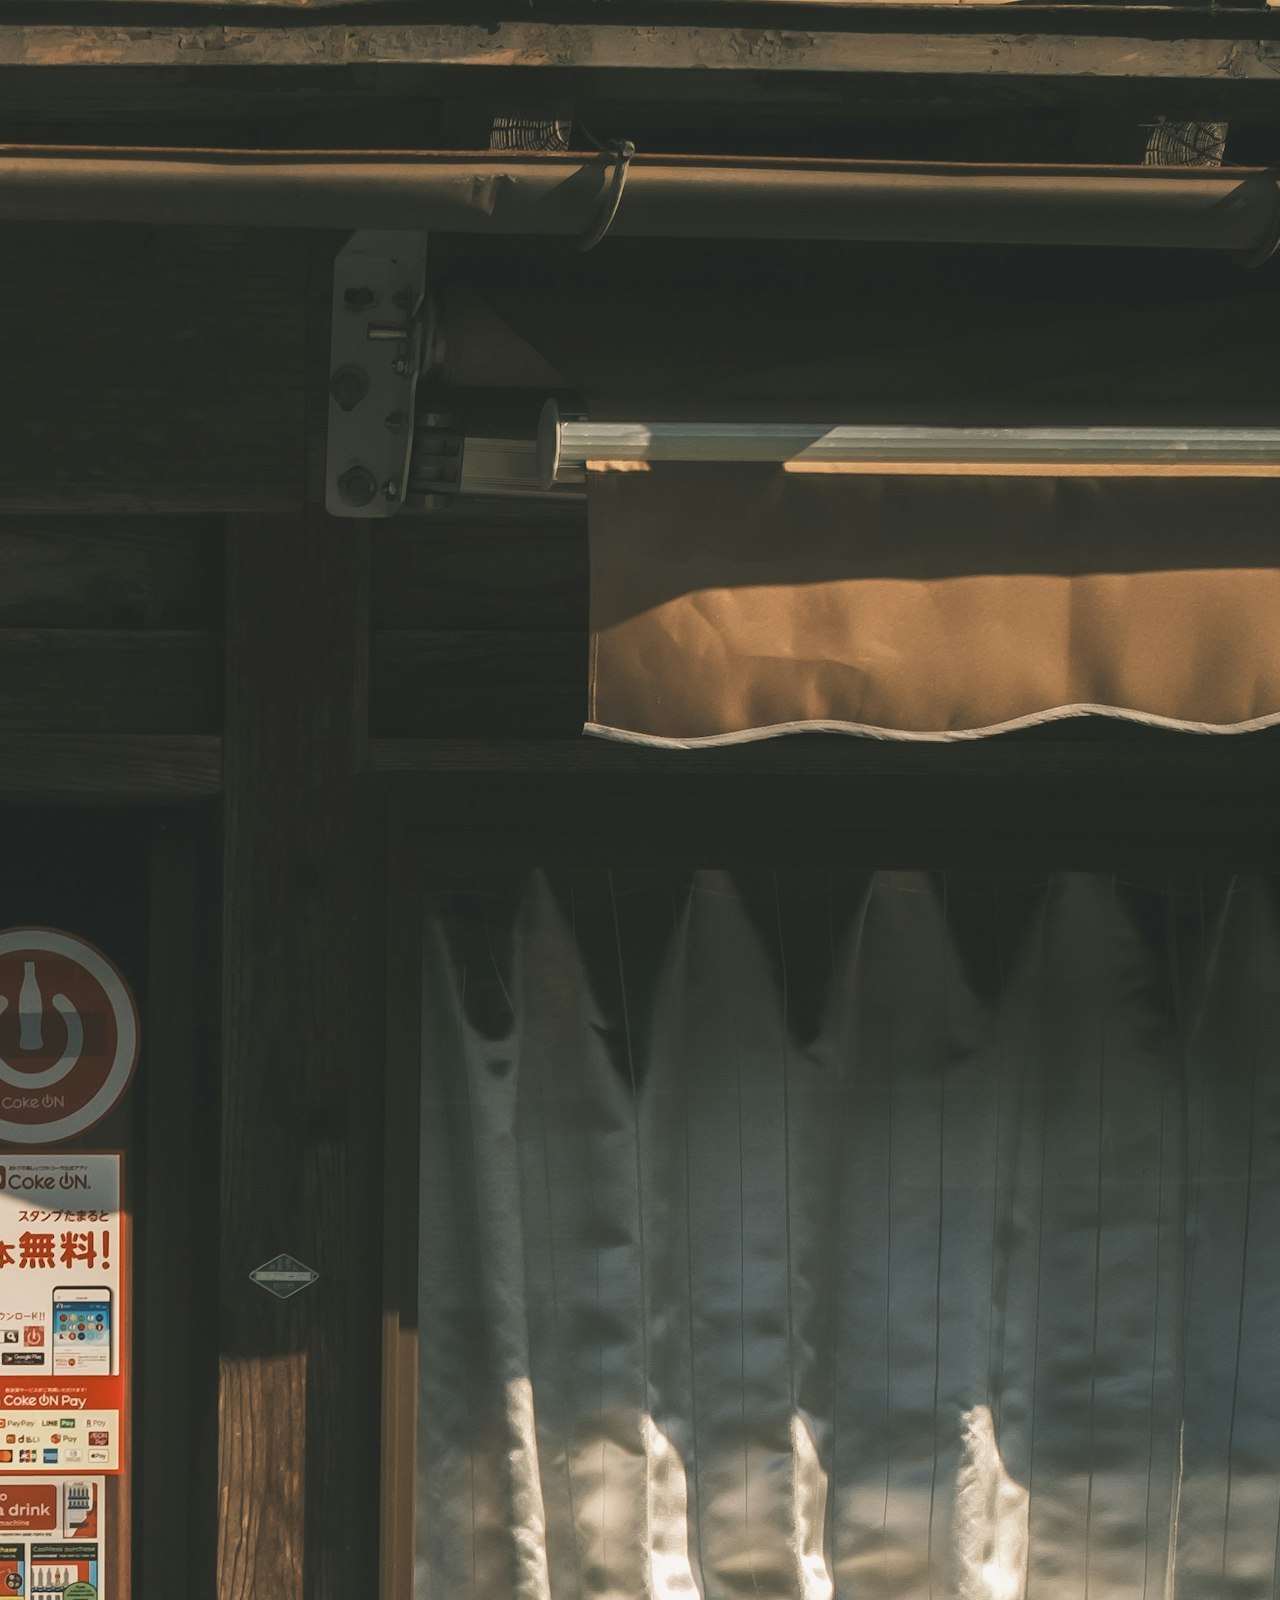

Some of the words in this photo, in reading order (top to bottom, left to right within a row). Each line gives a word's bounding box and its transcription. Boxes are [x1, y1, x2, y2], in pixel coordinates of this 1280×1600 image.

[18, 1209, 110, 1223] スタンプたまると
[3, 1394, 37, 1407] Coke
[38, 1392, 59, 1407] ON
[61, 1394, 88, 1410] Pay
[7, 1419, 35, 1428] PayPay
[8, 1503, 51, 1516] drink
